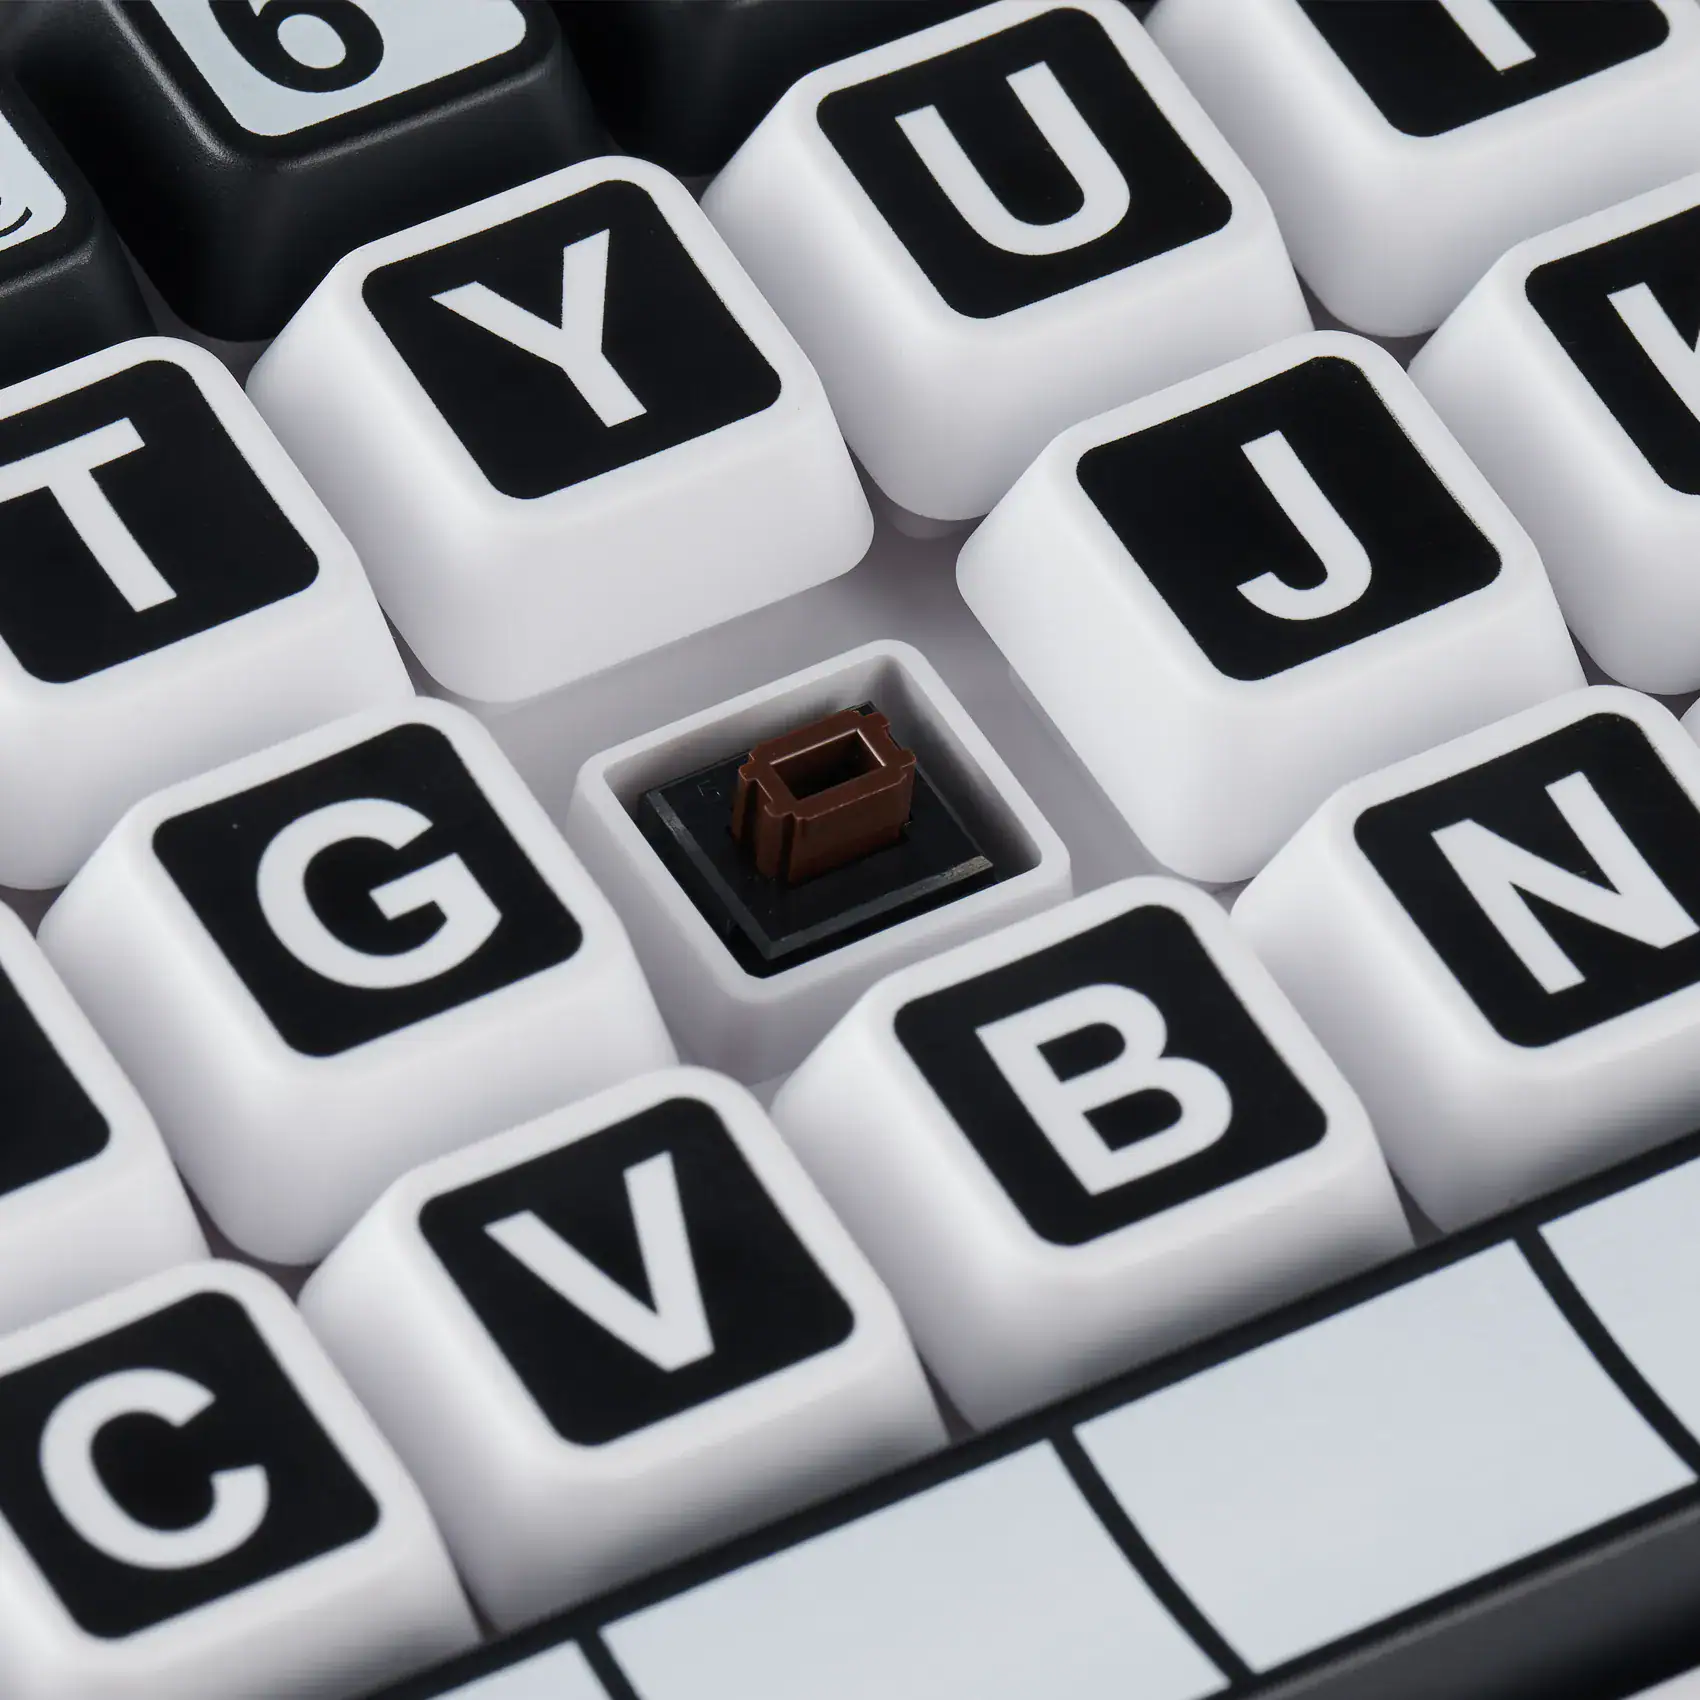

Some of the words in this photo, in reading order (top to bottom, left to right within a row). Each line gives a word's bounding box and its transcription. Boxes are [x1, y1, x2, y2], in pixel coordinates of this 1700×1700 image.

[896, 62, 1130, 256] U
[432, 229, 646, 427] Y
[0, 418, 177, 612] T
[1236, 431, 1372, 620] J
[257, 799, 501, 989] G
[1431, 771, 1700, 994] N
[976, 985, 1231, 1194] B
[485, 1152, 713, 1370] V
[38, 1369, 269, 1569] C
